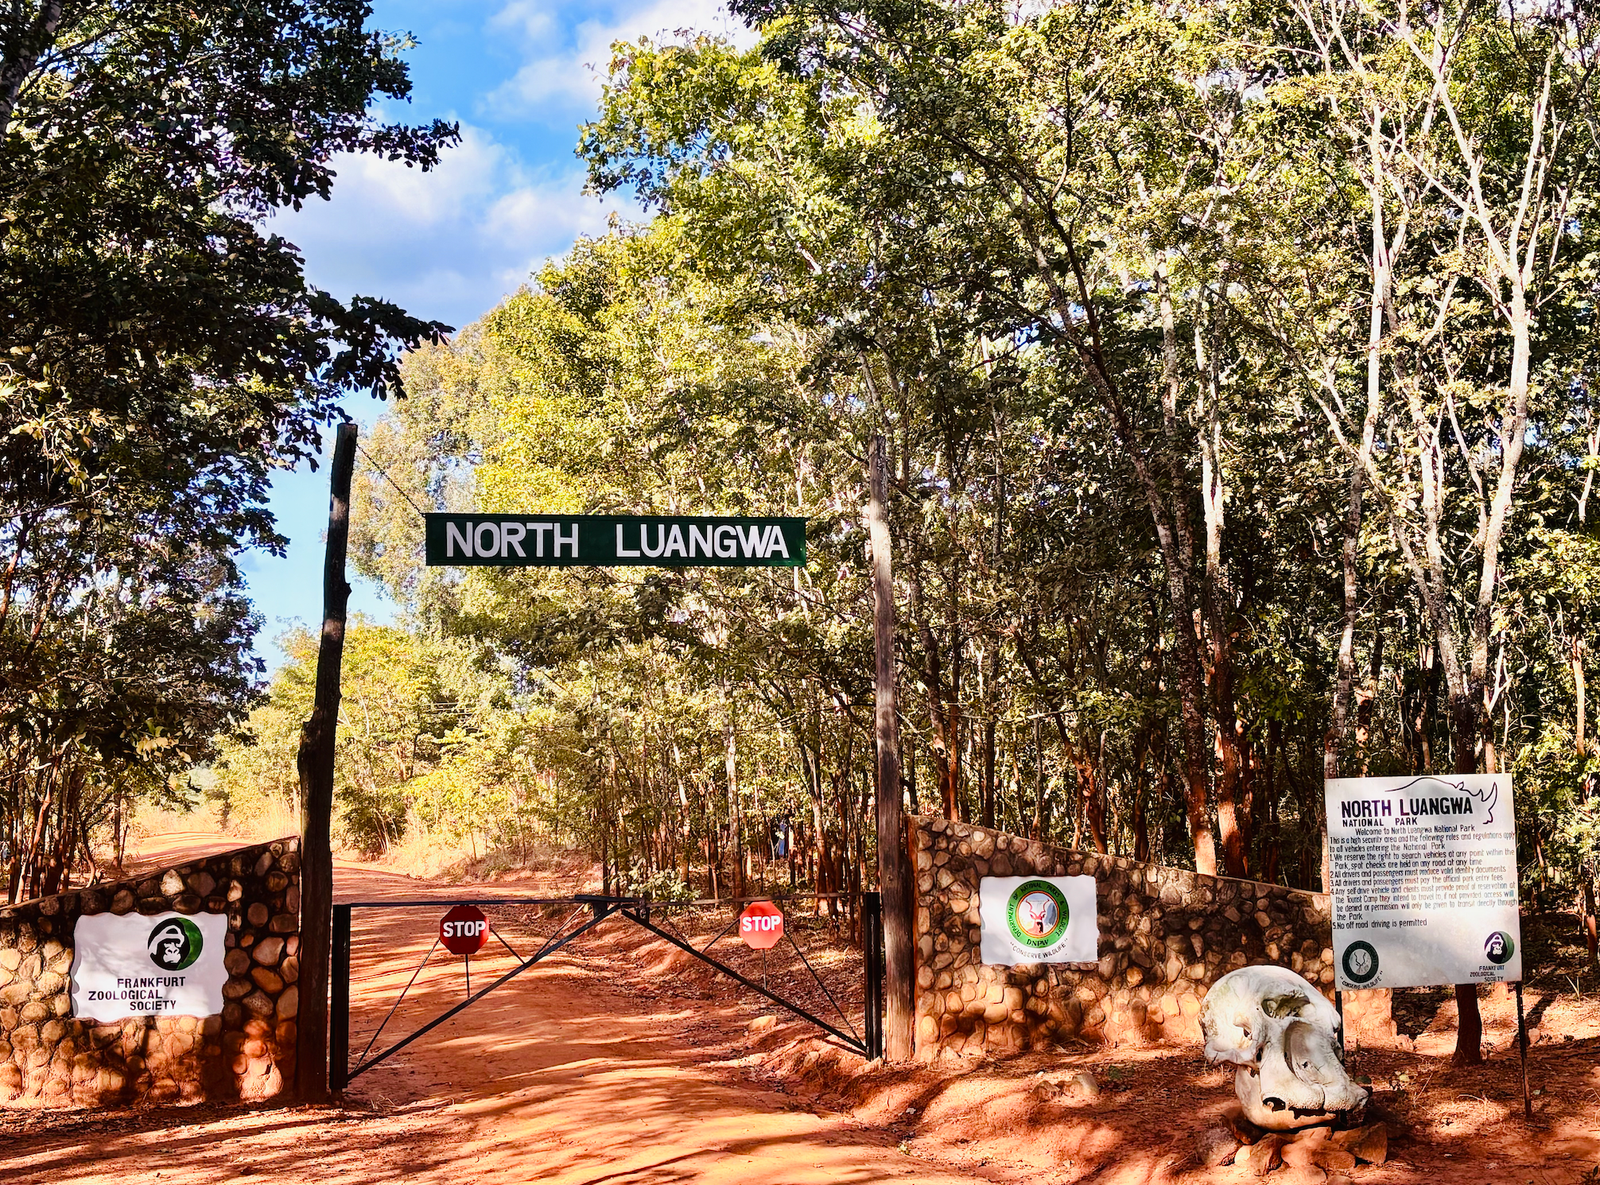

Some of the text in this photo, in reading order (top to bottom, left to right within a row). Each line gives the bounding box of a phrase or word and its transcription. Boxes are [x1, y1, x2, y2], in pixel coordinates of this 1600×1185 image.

[446, 522, 789, 559] NORTH LUANGWA
[1341, 797, 1473, 818] NORTH LUANGWA
[1343, 817, 1418, 827] NATIONAL PARK
[1355, 828, 1382, 836] Welcome
[1434, 825, 1457, 833] National
[1351, 837, 1360, 845] high
[1446, 832, 1459, 840] rules
[1461, 832, 1471, 840] and
[1367, 844, 1389, 852] entering
[1403, 843, 1427, 851] National
[1431, 841, 1445, 849] Park
[1378, 853, 1391, 861] right
[1400, 860, 1411, 868] held
[1420, 860, 1430, 868] any
[1373, 870, 1403, 878] passengers
[1462, 875, 1473, 883] park
[742, 915, 781, 932] STOP
[1346, 921, 1354, 929] off
[1371, 920, 1390, 928] driving
[1399, 919, 1427, 928] permitted
[443, 921, 486, 938] STOP
[117, 977, 185, 988] FRANKFURT
[88, 990, 163, 1000] ZOOLOGICAL
[130, 1000, 176, 1010] SOCIETY
